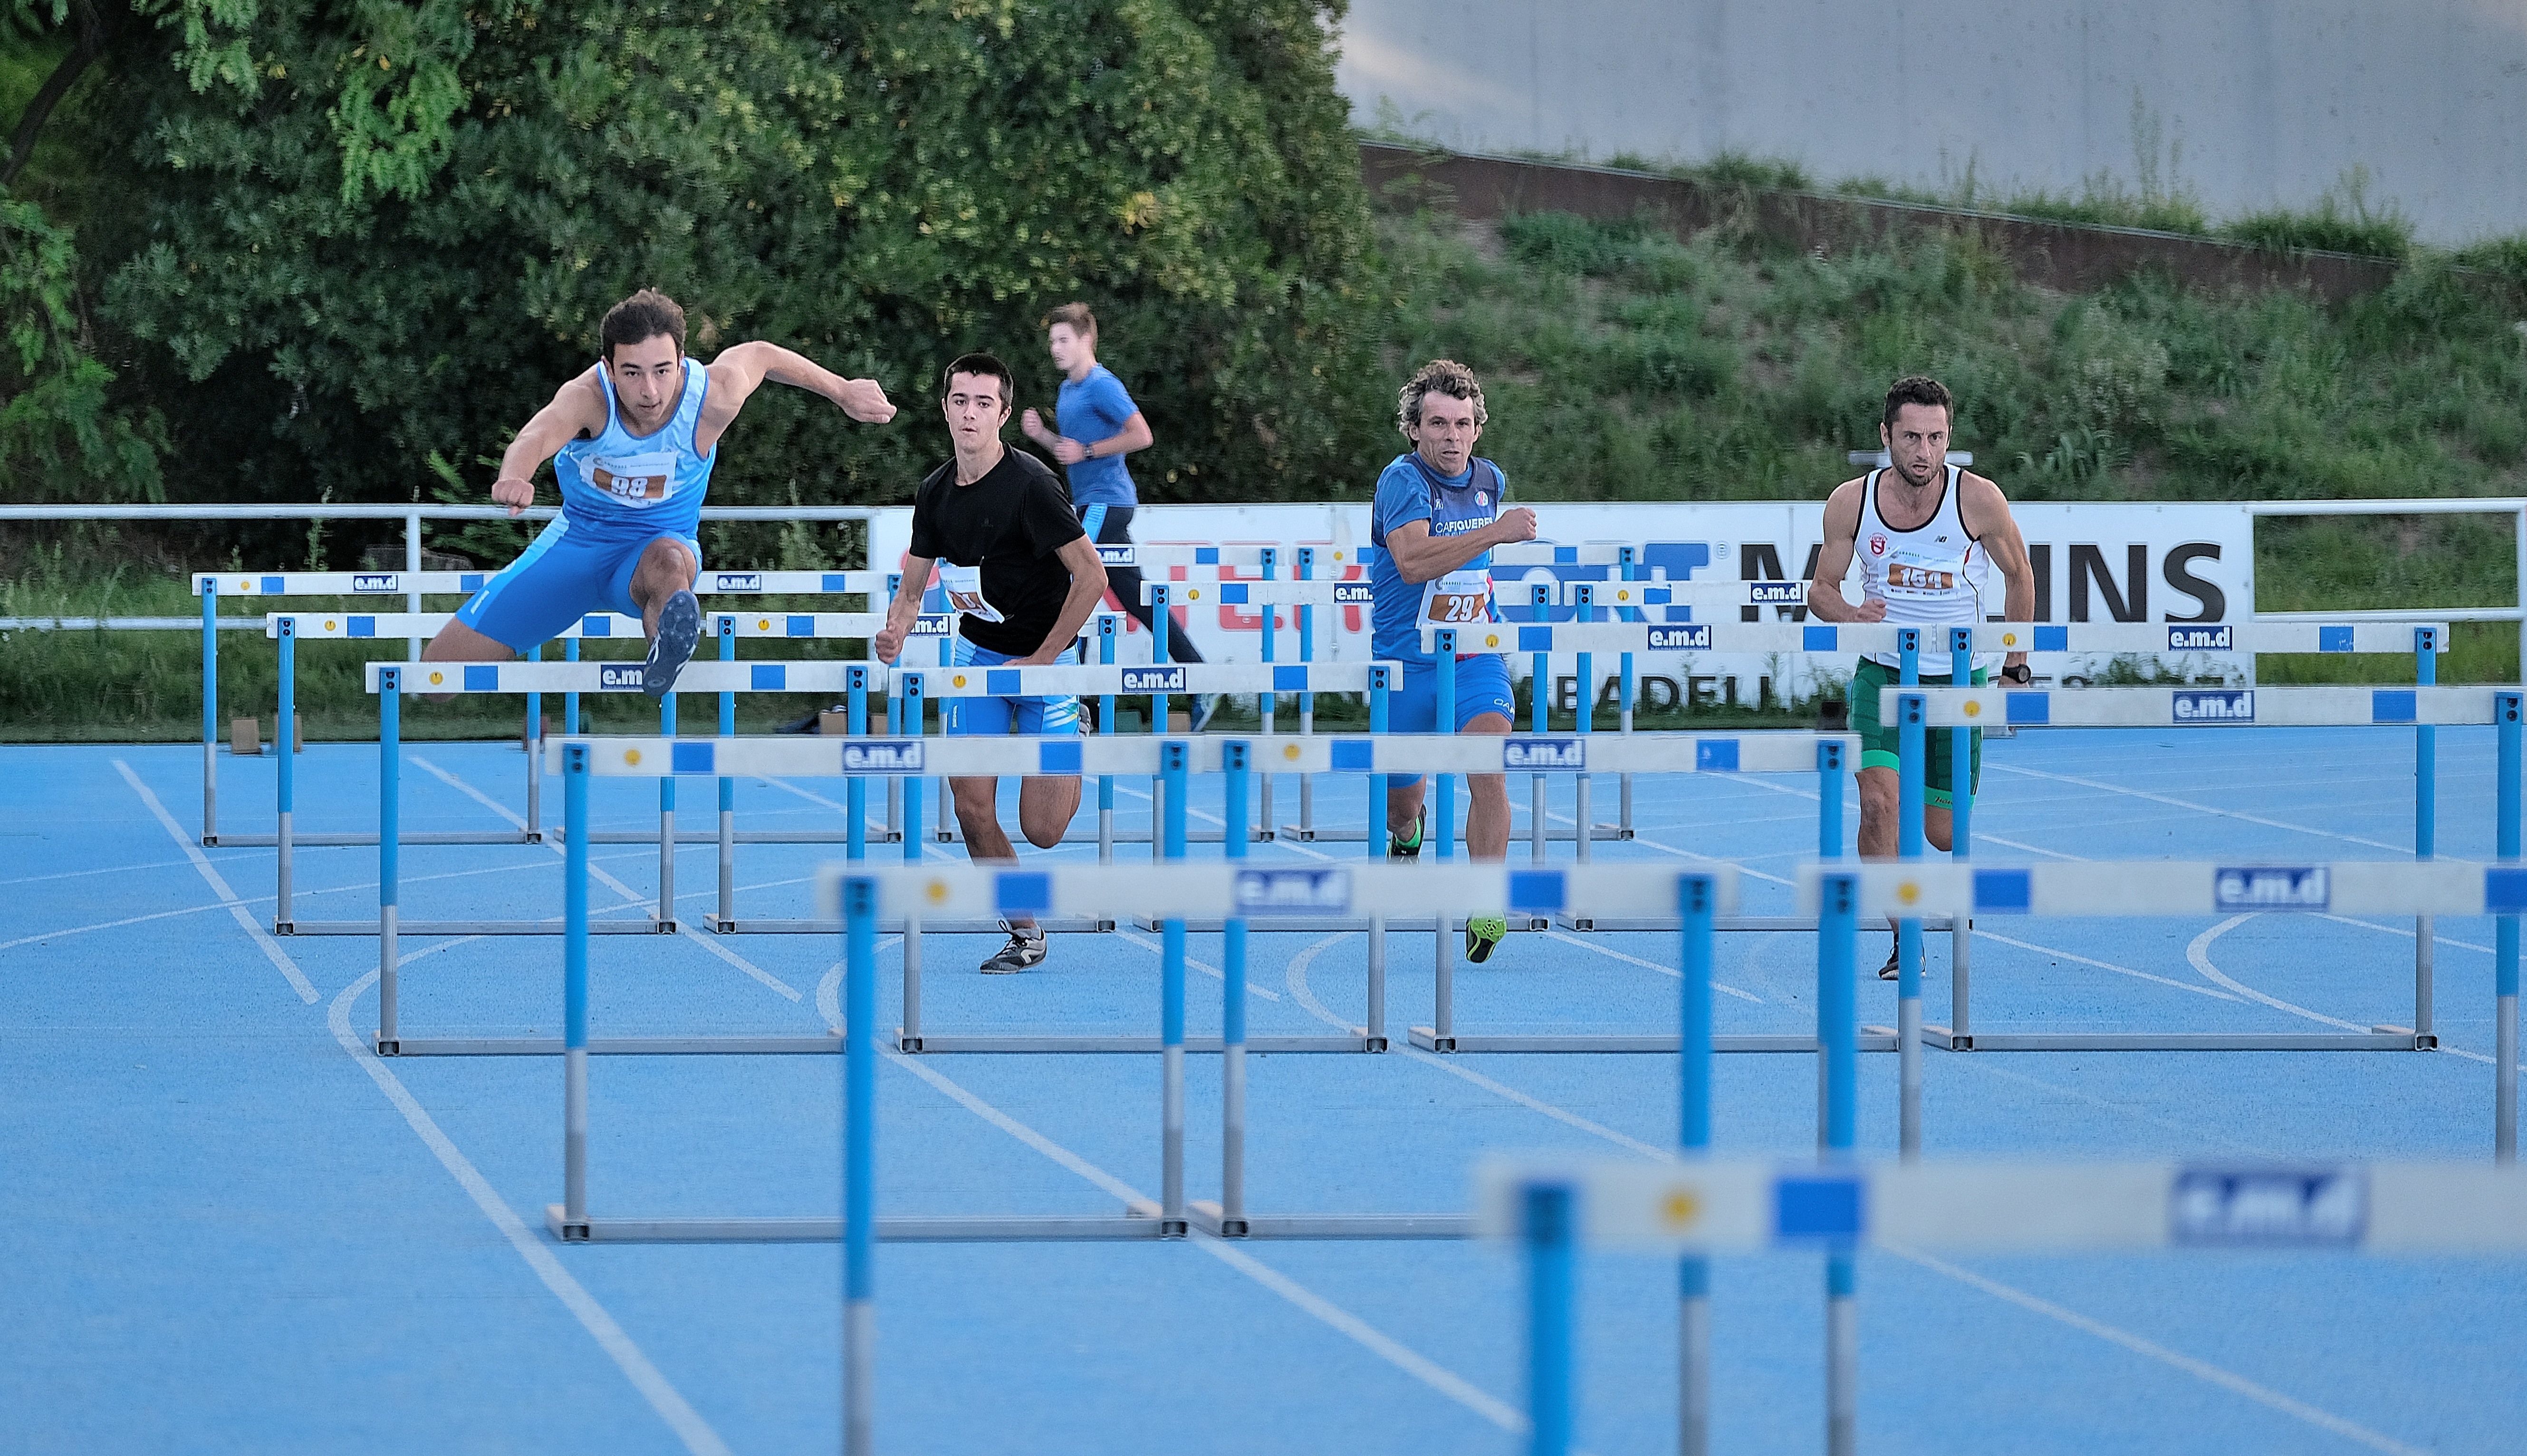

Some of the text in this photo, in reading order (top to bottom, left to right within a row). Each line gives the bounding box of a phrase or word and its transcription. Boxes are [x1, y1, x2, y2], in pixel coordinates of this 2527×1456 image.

[611, 476, 648, 497] 98
[355, 575, 396, 590] e.m.d
[718, 575, 760, 589] e.m.d
[1741, 543, 2226, 623] MINS
[1901, 567, 1942, 589] 154
[1336, 587, 1373, 600] e.m.
[1752, 583, 1801, 600] e.m.d
[1445, 595, 1475, 622] 29
[1649, 625, 1709, 646] e.m.d
[2171, 626, 2230, 647] e.m.d
[1124, 668, 1183, 689] e.m.d
[2175, 691, 2252, 718] e.m.d
[846, 742, 921, 768] e.m.d
[1506, 740, 1582, 766] e.m.d
[2219, 869, 2325, 903] e.m.d
